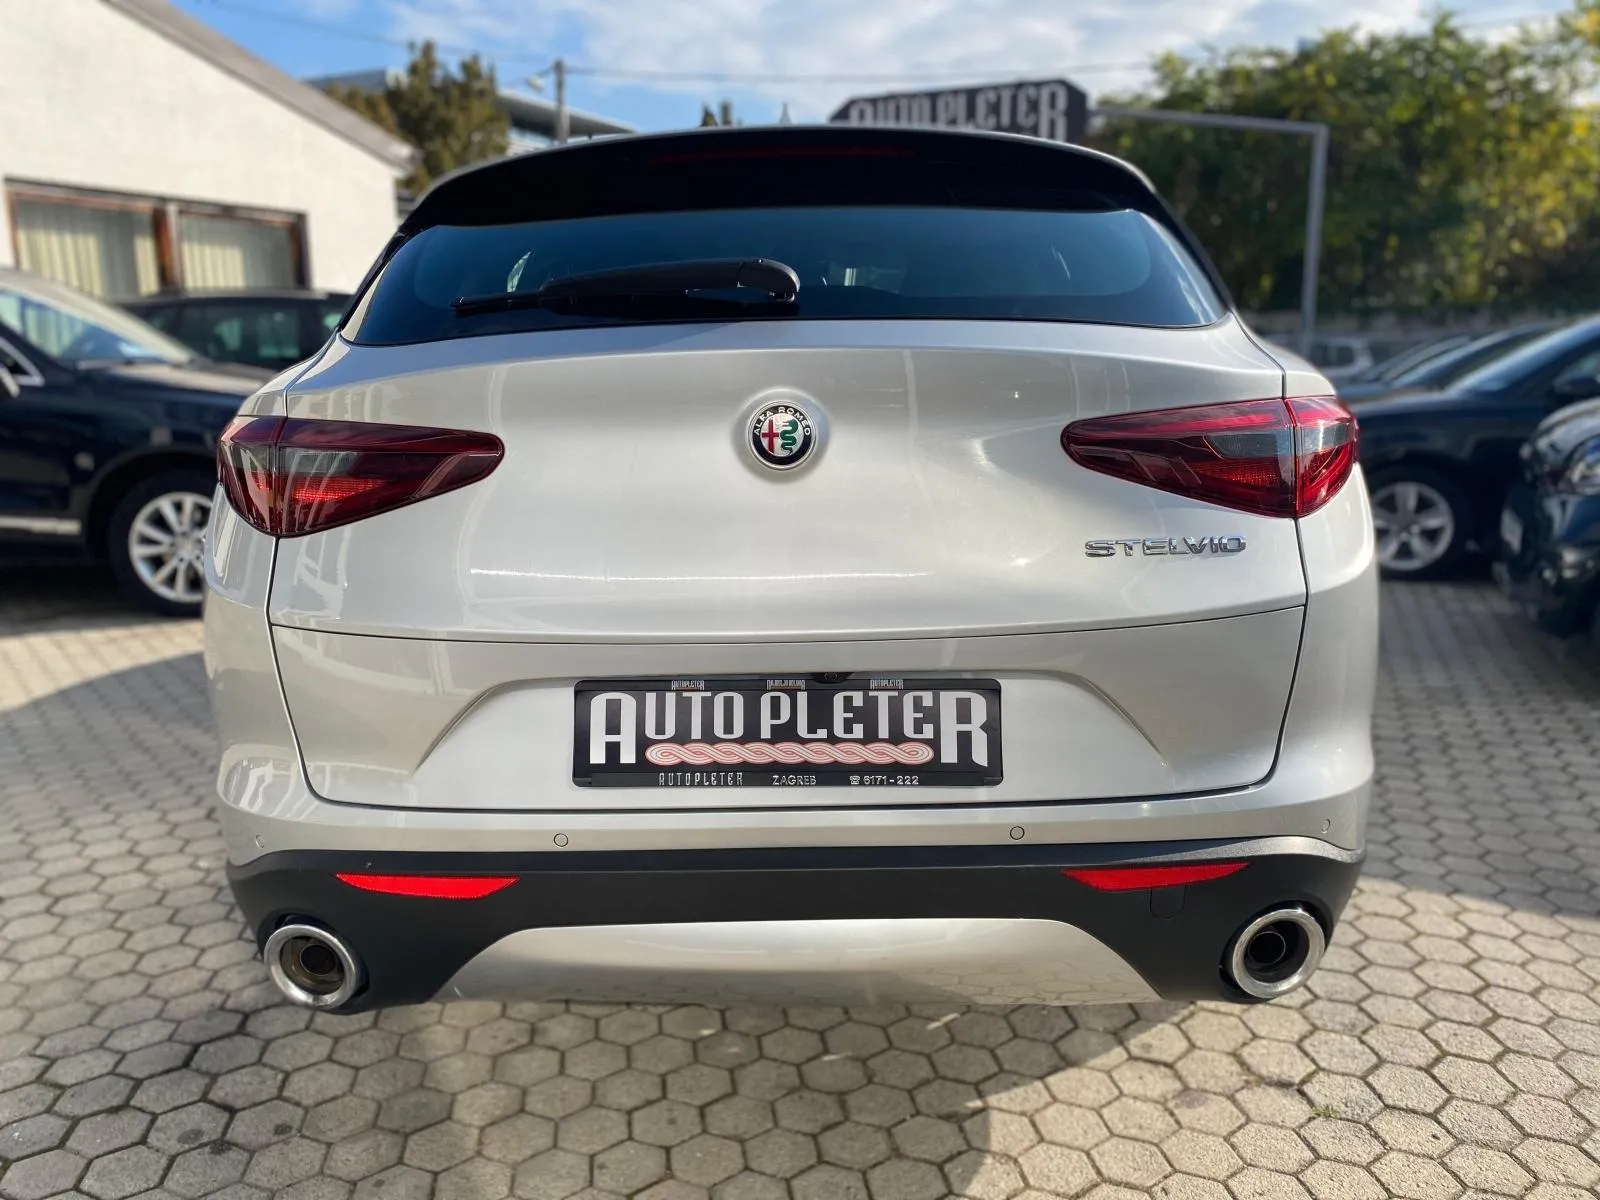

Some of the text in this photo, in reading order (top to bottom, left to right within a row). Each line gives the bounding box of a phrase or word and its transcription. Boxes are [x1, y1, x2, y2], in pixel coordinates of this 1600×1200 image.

[754, 407, 811, 436] ALFA ROMEO
[1085, 536, 1246, 557] STELVIO
[589, 691, 988, 767] AUTO PLETER
[659, 772, 743, 786] AUTOPLETER
[772, 775, 817, 786] ZAGREB
